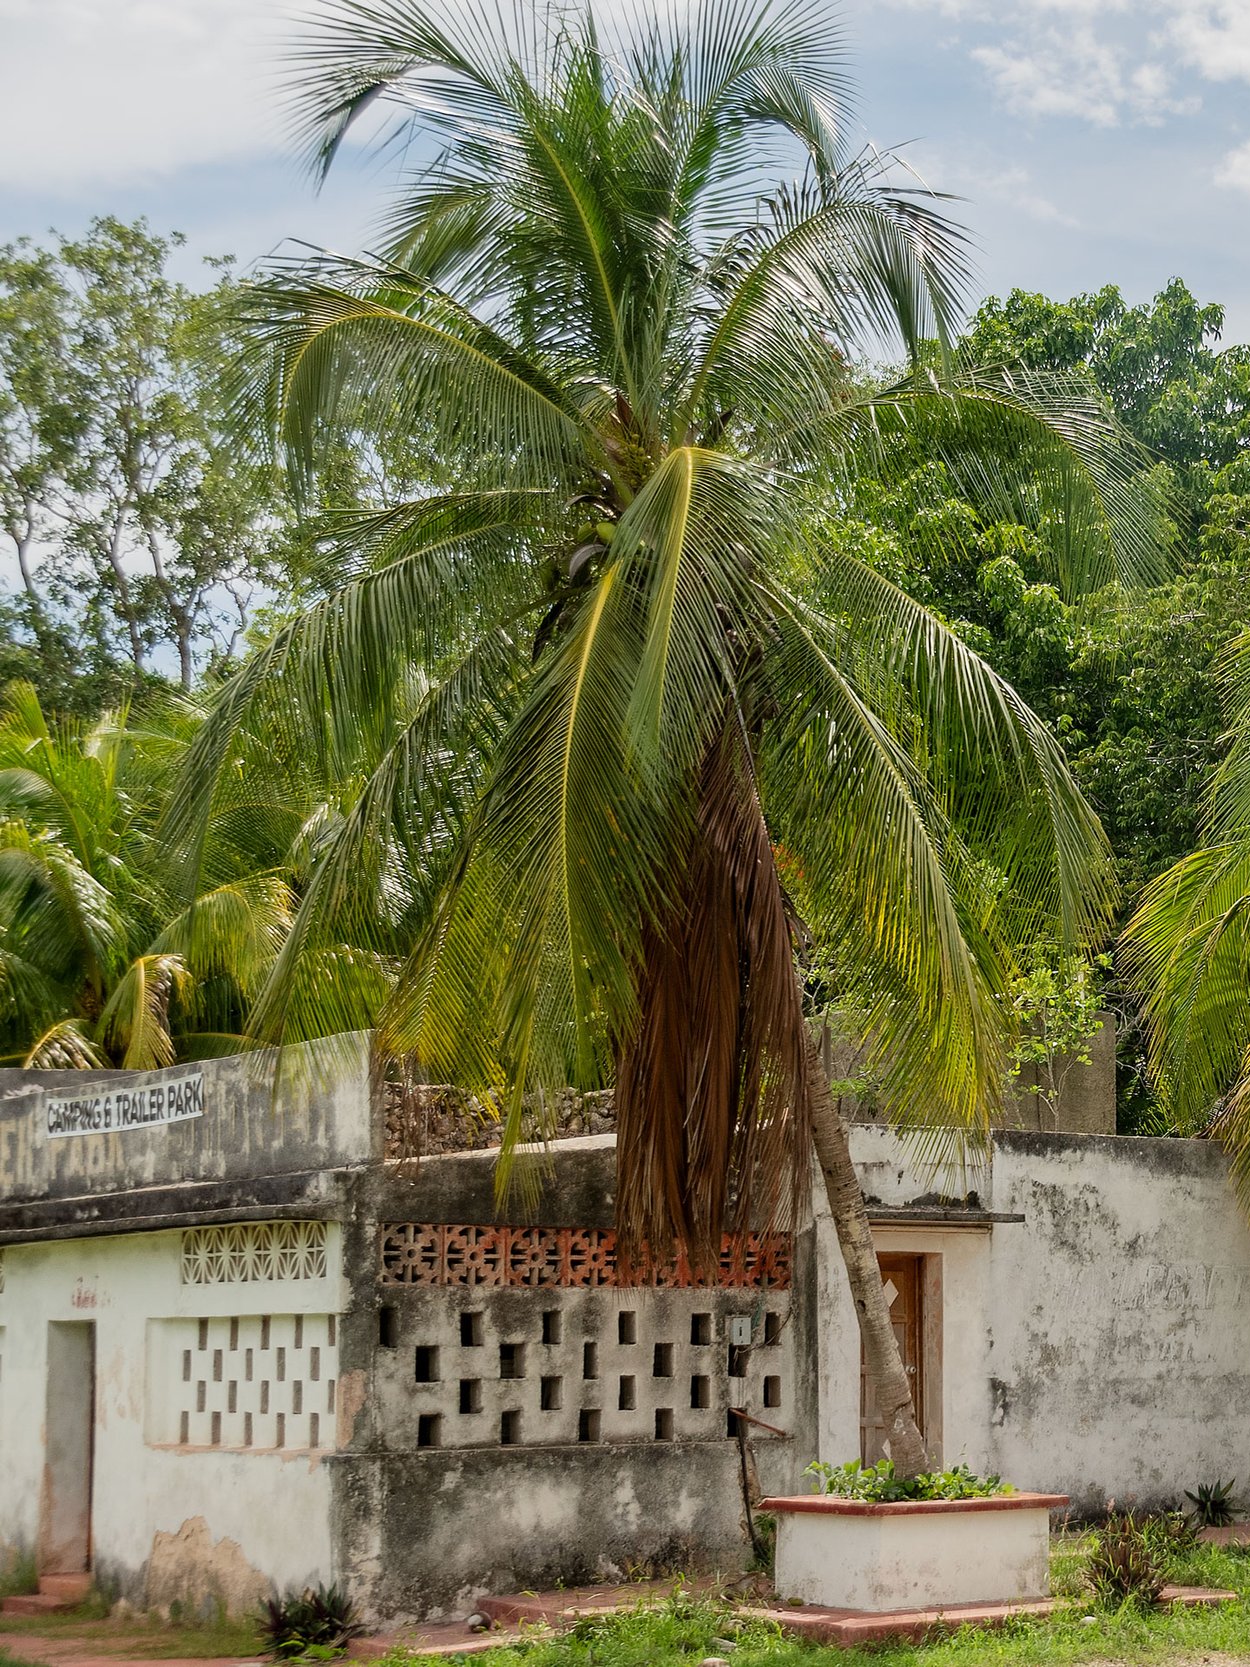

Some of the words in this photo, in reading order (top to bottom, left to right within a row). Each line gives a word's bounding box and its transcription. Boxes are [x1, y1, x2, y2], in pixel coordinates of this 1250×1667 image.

[47, 1099, 102, 1133] CAMPING
[116, 1087, 165, 1127] TRAILER
[167, 1078, 203, 1118] PARK
